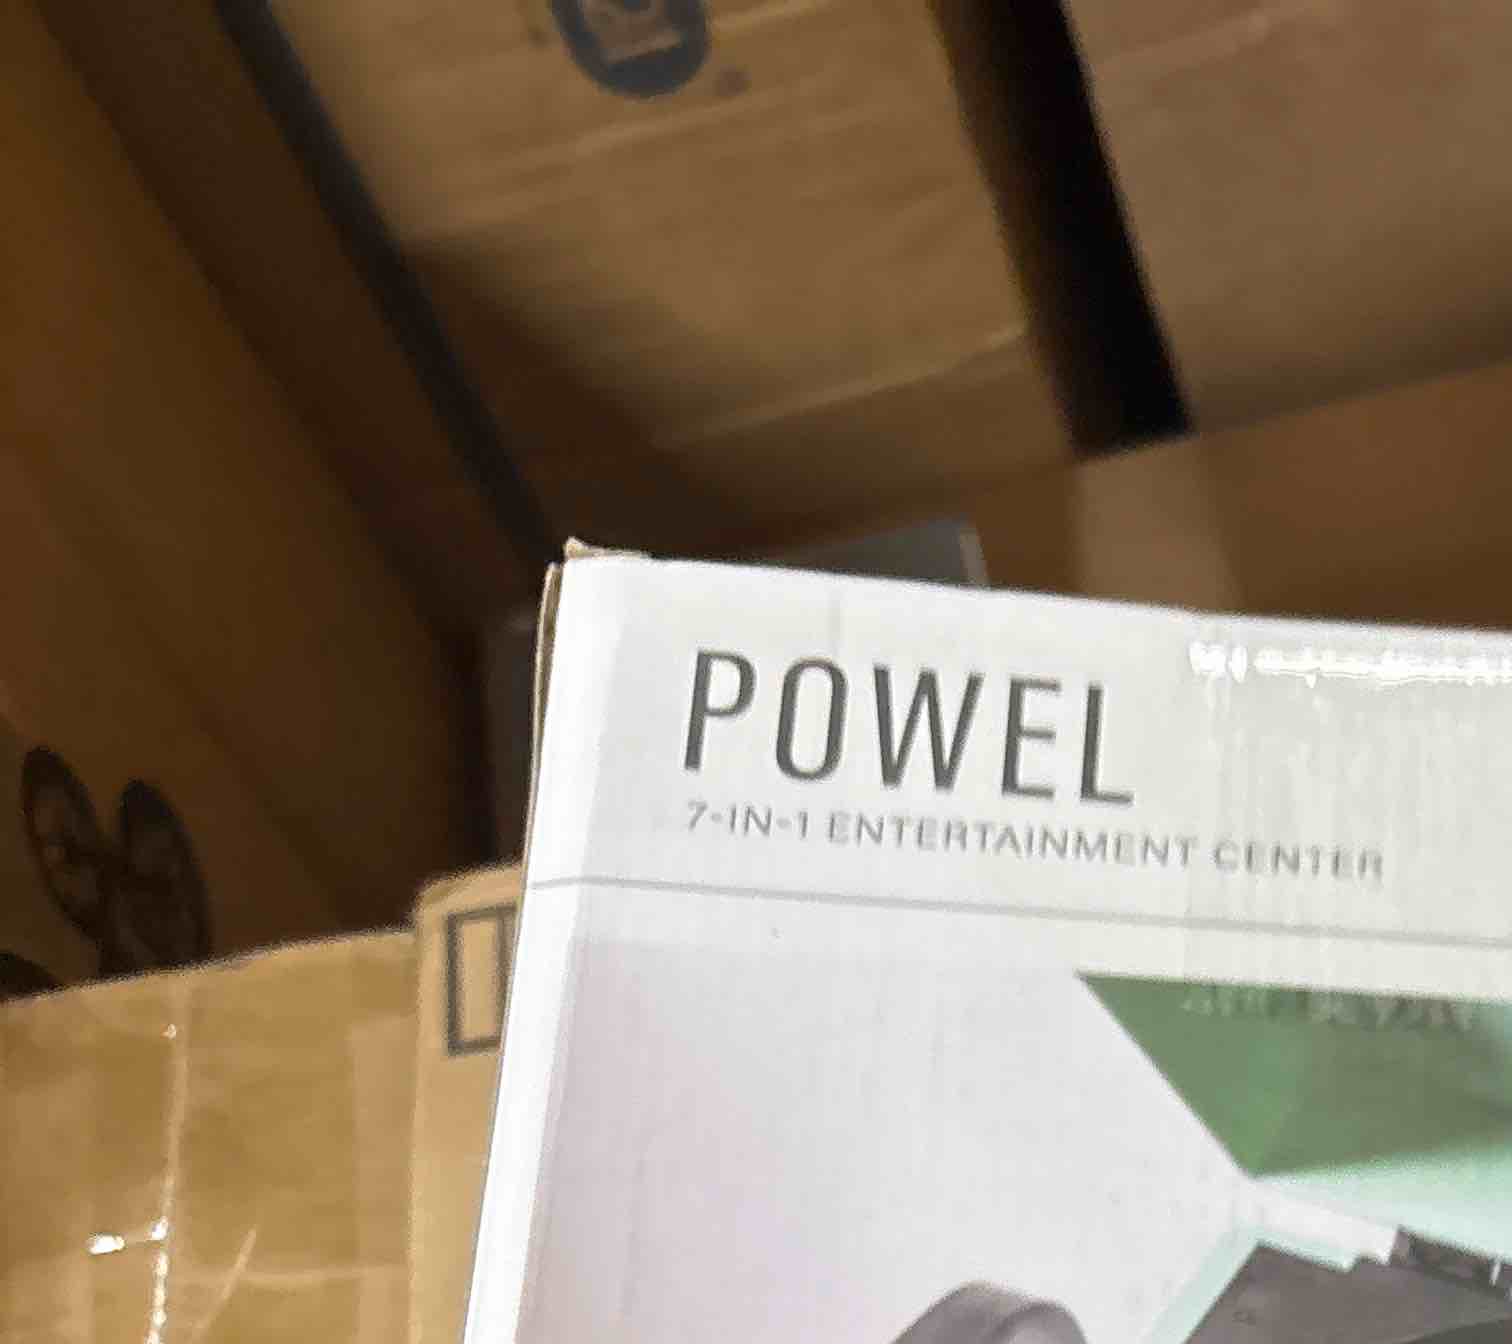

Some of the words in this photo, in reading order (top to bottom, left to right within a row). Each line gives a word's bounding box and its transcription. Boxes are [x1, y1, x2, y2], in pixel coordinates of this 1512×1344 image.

[684, 648, 1135, 805] POWEL
[687, 800, 811, 840] 7-IN-1
[828, 812, 1198, 869] ENTERTAINMENT
[1210, 836, 1385, 881] CENTER
